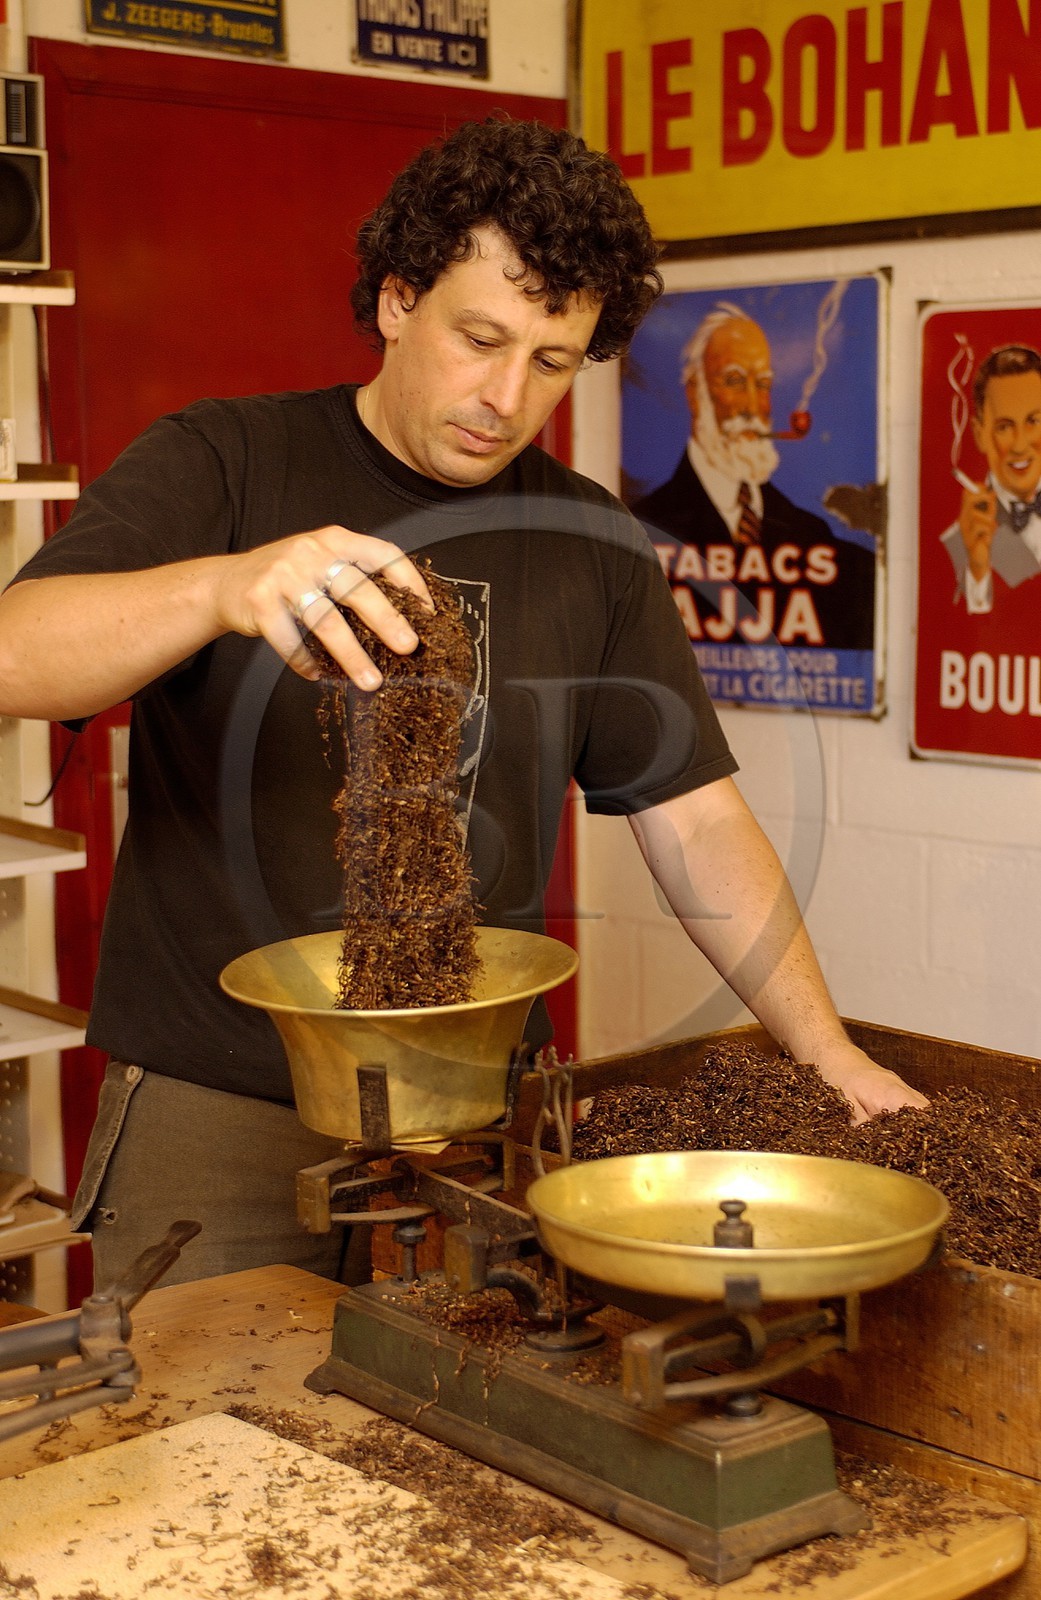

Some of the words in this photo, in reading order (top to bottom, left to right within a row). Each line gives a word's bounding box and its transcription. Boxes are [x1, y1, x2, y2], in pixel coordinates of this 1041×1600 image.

[103, 2, 122, 22] J.
[371, 30, 393, 55] EN
[395, 34, 443, 63] VENTE
[448, 41, 477, 67] ICI
[606, 37, 692, 180] LE
[653, 543, 838, 584] TABACS
[788, 651, 838, 674] POUR
[721, 675, 745, 697] LA
[748, 674, 866, 705] CIGARETTE
[940, 650, 1041, 717] BOUL
